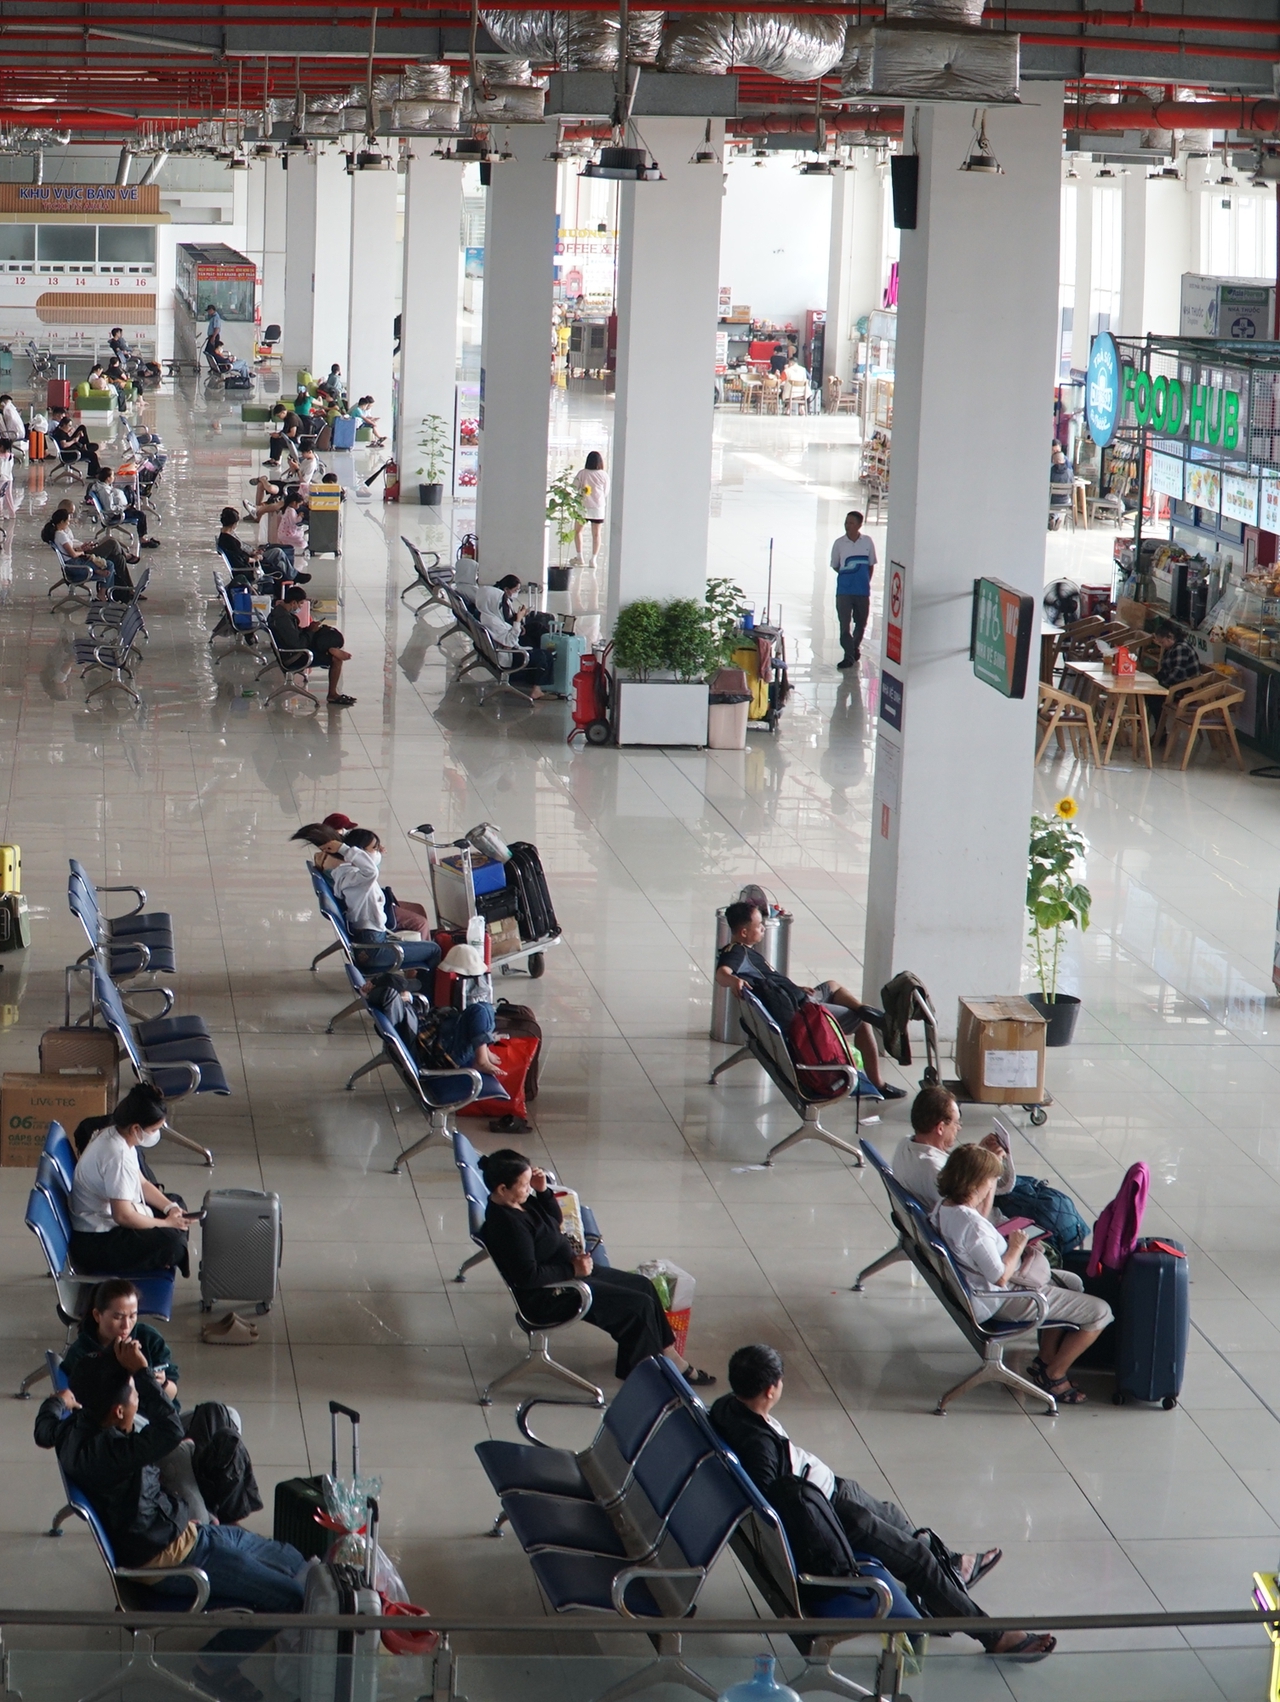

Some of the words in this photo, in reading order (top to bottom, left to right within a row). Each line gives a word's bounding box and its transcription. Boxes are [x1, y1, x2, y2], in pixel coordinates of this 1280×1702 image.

[20, 188, 50, 200] KHU
[54, 186, 83, 204] VỰC
[87, 185, 116, 200] BÁN
[120, 185, 139, 200] VÉ
[556, 243, 598, 254] OFFEE
[15, 277, 26, 285] 12
[48, 277, 59, 285] 13
[75, 278, 86, 286] 14
[109, 278, 120, 286] 15
[1121, 365, 1184, 436] FOOD
[1189, 383, 1240, 450] HUB
[1005, 602, 1019, 638] WC
[9, 1115, 33, 1129] 06
